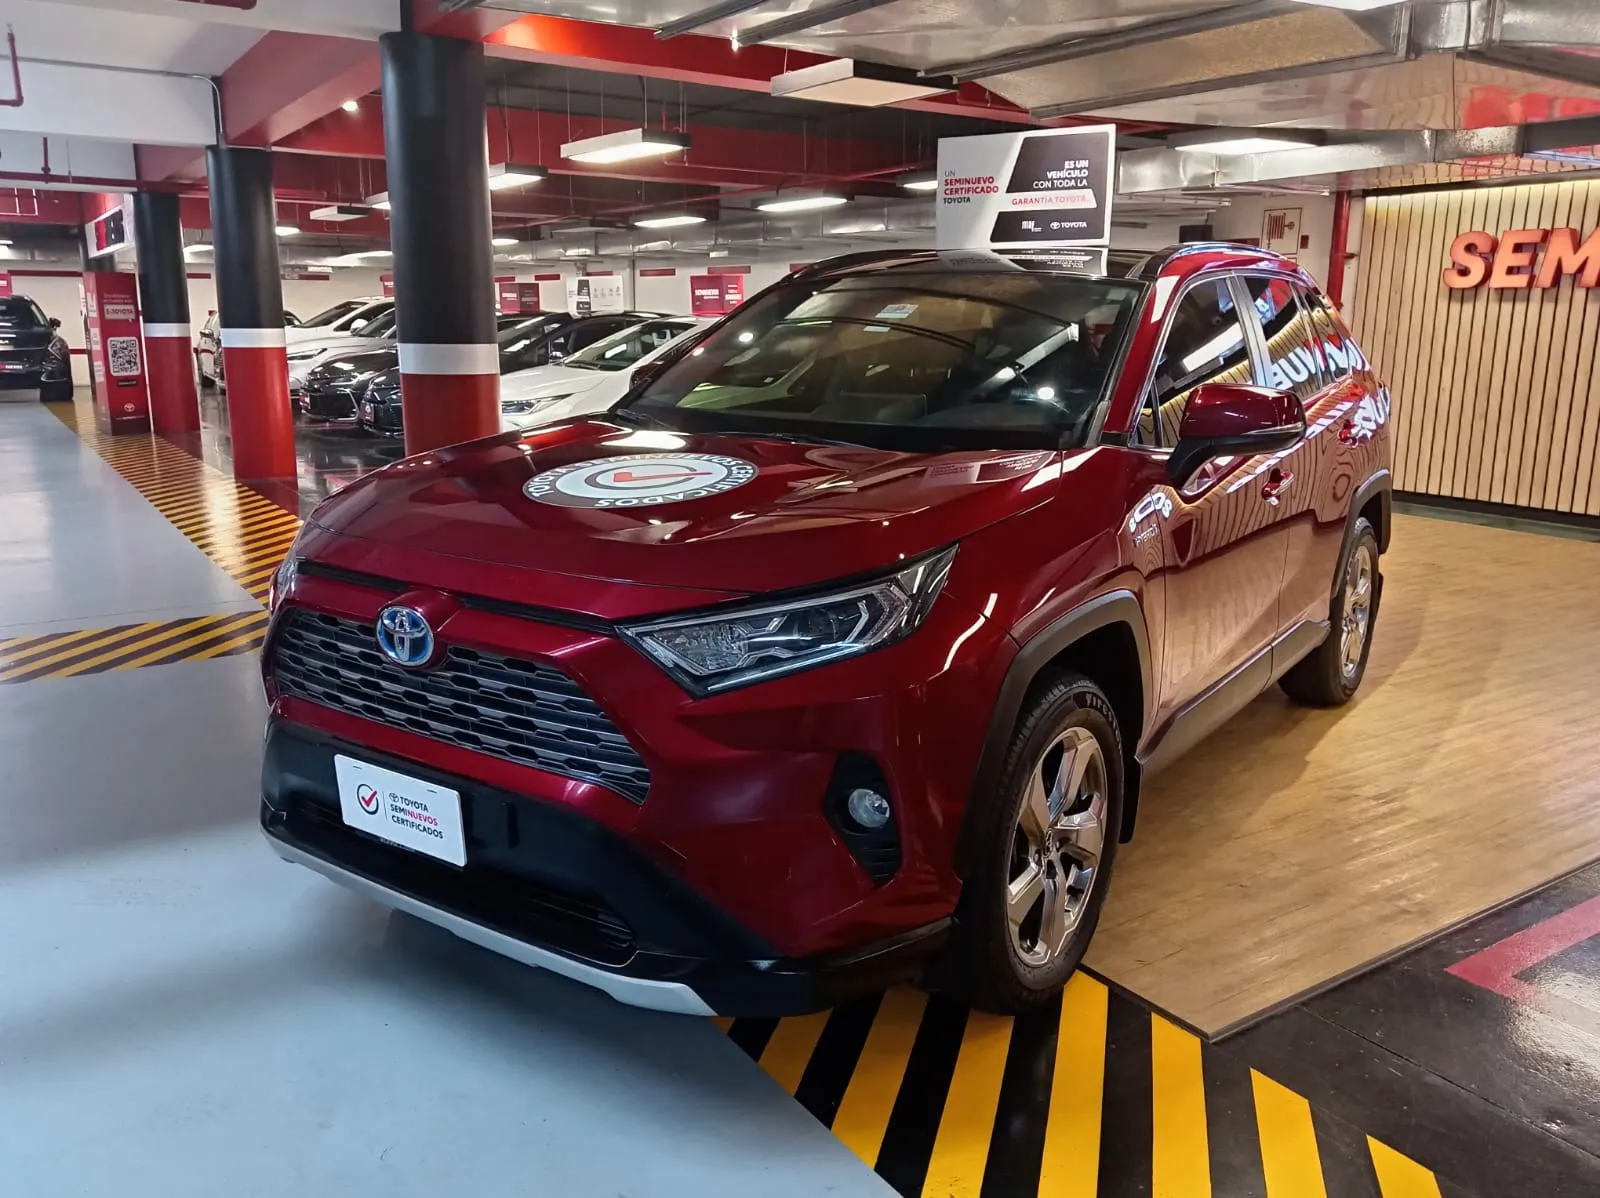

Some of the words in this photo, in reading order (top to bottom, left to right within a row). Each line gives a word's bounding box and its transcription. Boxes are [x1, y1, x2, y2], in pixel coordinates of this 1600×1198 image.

[1065, 160, 1075, 169] ES
[1076, 160, 1089, 168] UN
[944, 170, 955, 178] UN
[1046, 168, 1089, 179] VEHÍCULO
[944, 176, 995, 187] SEMINUEVO
[1033, 181, 1052, 189] CON
[1053, 179, 1076, 188] TODA
[1078, 178, 1088, 187] LA
[943, 186, 999, 196] CERTIFICADO
[943, 197, 971, 205] TOYOTA
[1011, 195, 1053, 206] GARANTÍA
[528, 467, 576, 497] TOYOTA
[594, 464, 755, 507] CERTIFICADOS
[399, 796, 429, 813] TOYOTA
[390, 803, 438, 826] SEMINUEVOS
[391, 815, 444, 839] CERTIFICADOS
